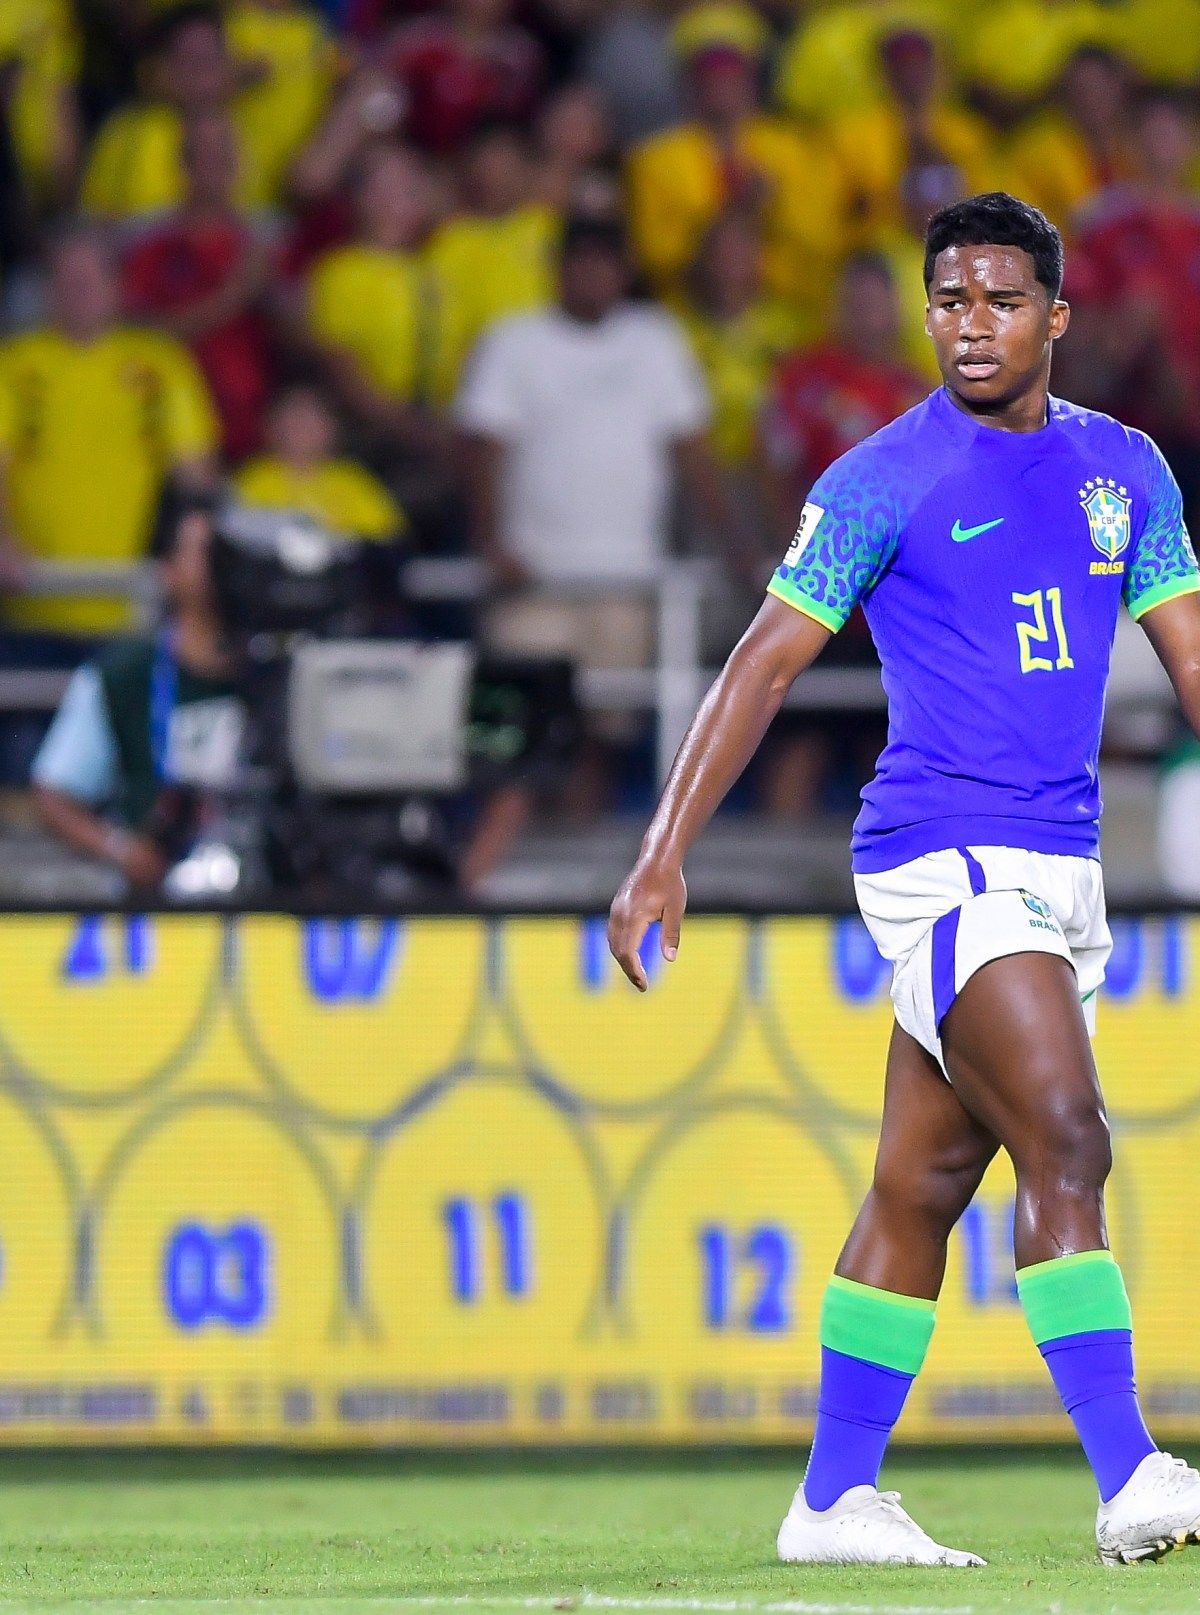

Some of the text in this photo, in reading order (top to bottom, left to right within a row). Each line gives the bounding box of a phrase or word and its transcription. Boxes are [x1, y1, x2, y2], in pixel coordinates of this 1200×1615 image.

[1101, 516, 1117, 525] CBF
[1011, 586, 1075, 674] 21
[163, 1220, 271, 1332] 03
[445, 1193, 531, 1301] 11
[701, 1225, 796, 1333] 12
